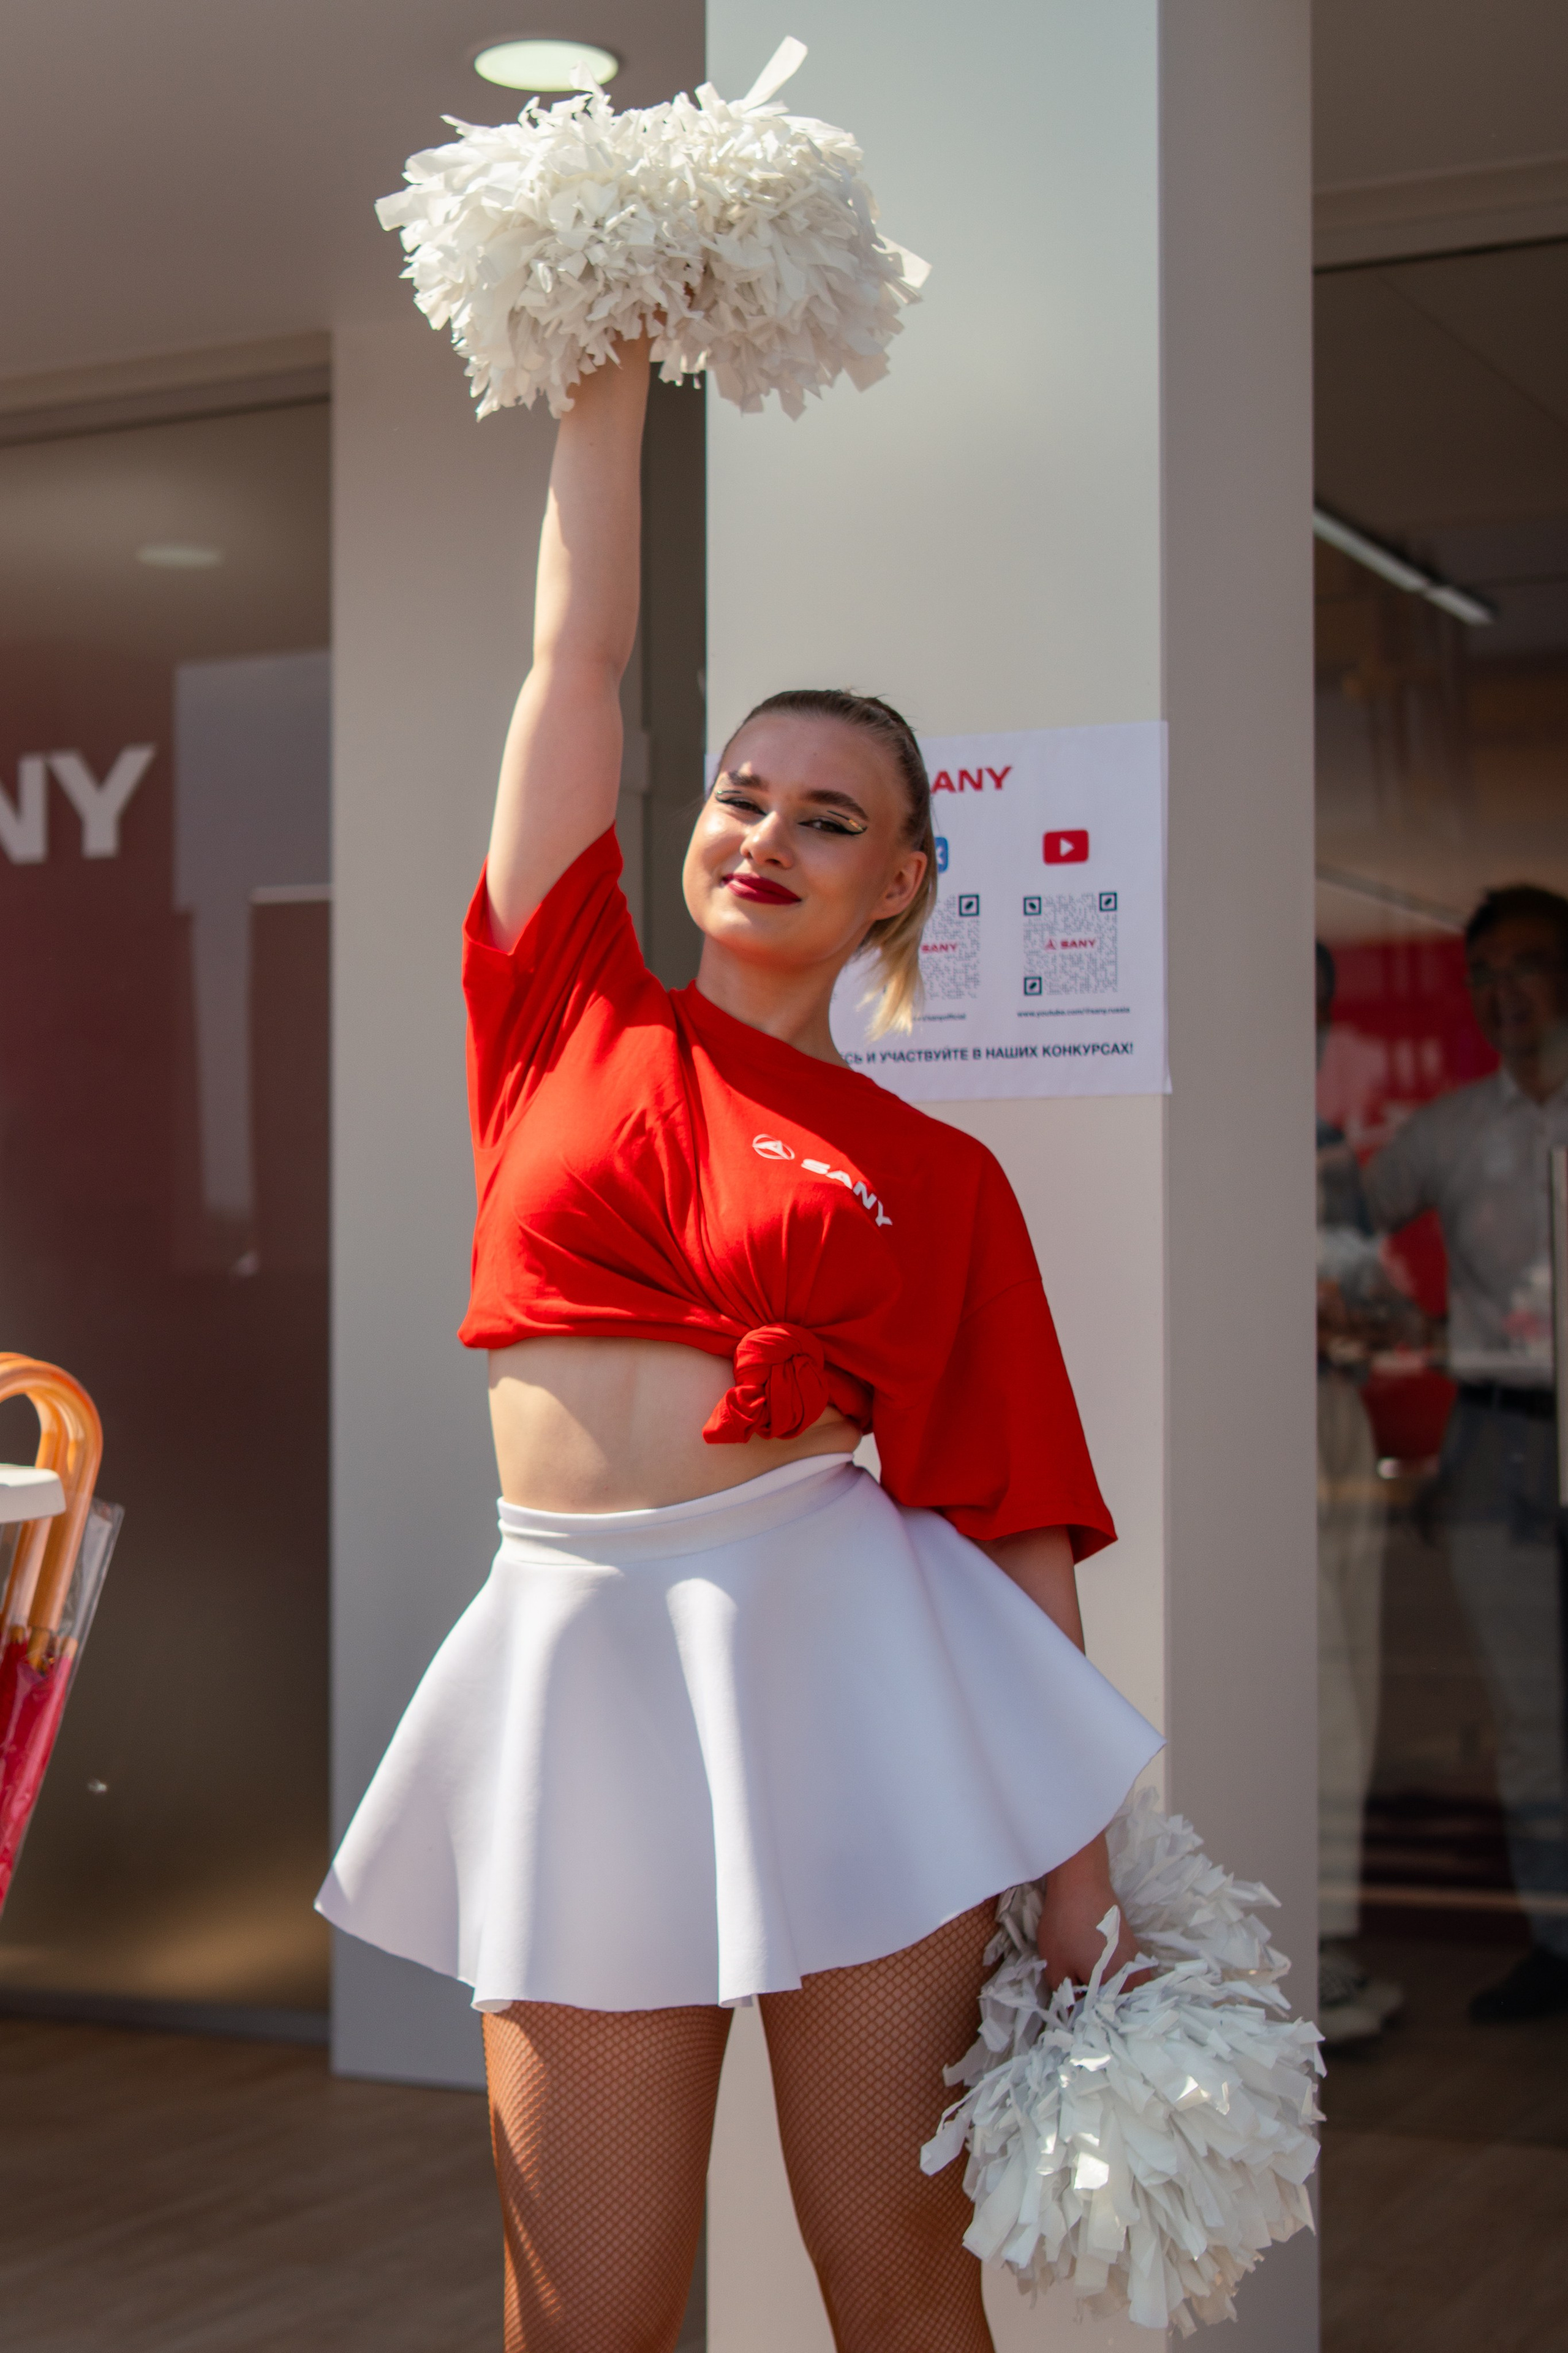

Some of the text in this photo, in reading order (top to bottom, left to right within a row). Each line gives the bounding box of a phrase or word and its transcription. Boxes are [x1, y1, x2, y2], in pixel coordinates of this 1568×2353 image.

[930, 765, 1012, 795] ANY
[841, 1041, 1133, 1065] СЬ И УЧАСТВУЙТЕ В НАШИХ КОНКУРСАХ!
[801, 1158, 892, 1227] SANY
